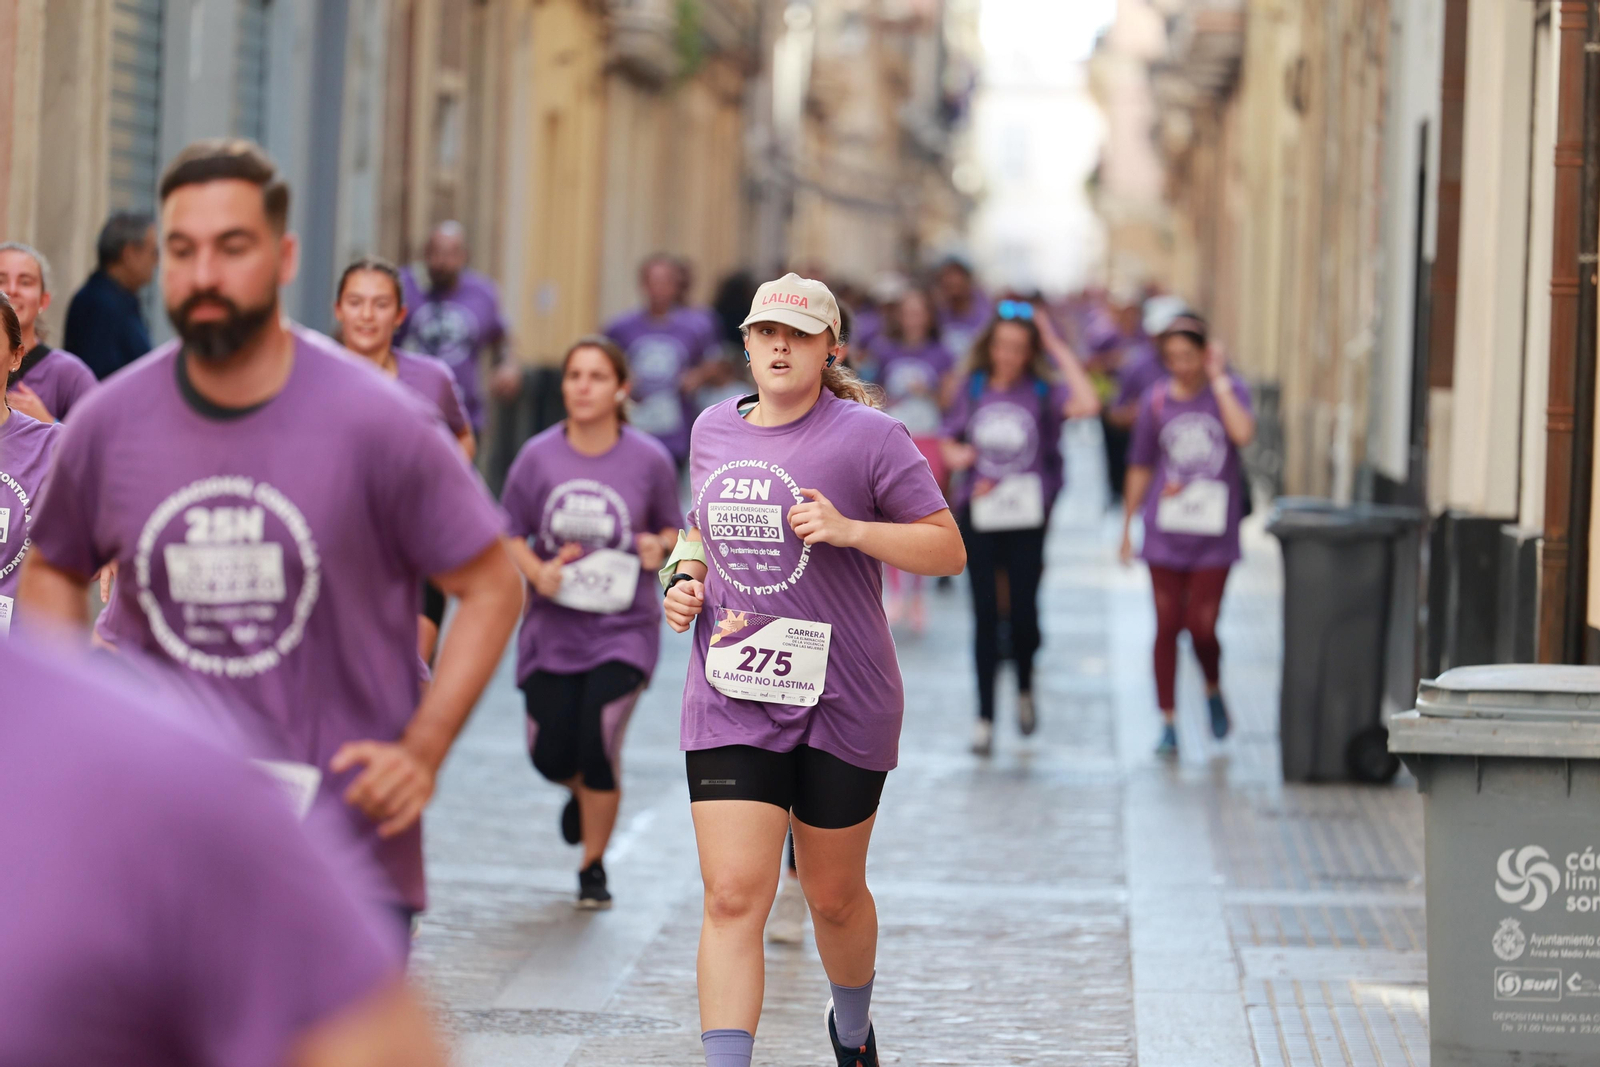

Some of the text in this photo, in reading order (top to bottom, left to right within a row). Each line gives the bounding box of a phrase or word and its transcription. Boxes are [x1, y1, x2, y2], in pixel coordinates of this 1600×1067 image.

[762, 293, 808, 309] LALIGA
[697, 460, 768, 505] INTERNACIONAL
[719, 477, 772, 501] 25N
[740, 506, 779, 514] EMERGENCIAS
[716, 512, 769, 525] 24 HORAS
[712, 525, 778, 538] 900 21 21 30
[787, 541, 812, 584] OLENCIA
[754, 581, 788, 596] HACIA
[787, 627, 825, 639] CARRERA
[736, 646, 793, 677] 275
[712, 669, 816, 691] EL AMOR NO LASTIMA
[1565, 871, 1600, 896] lim
[1530, 933, 1595, 948] Ayuntamiento
